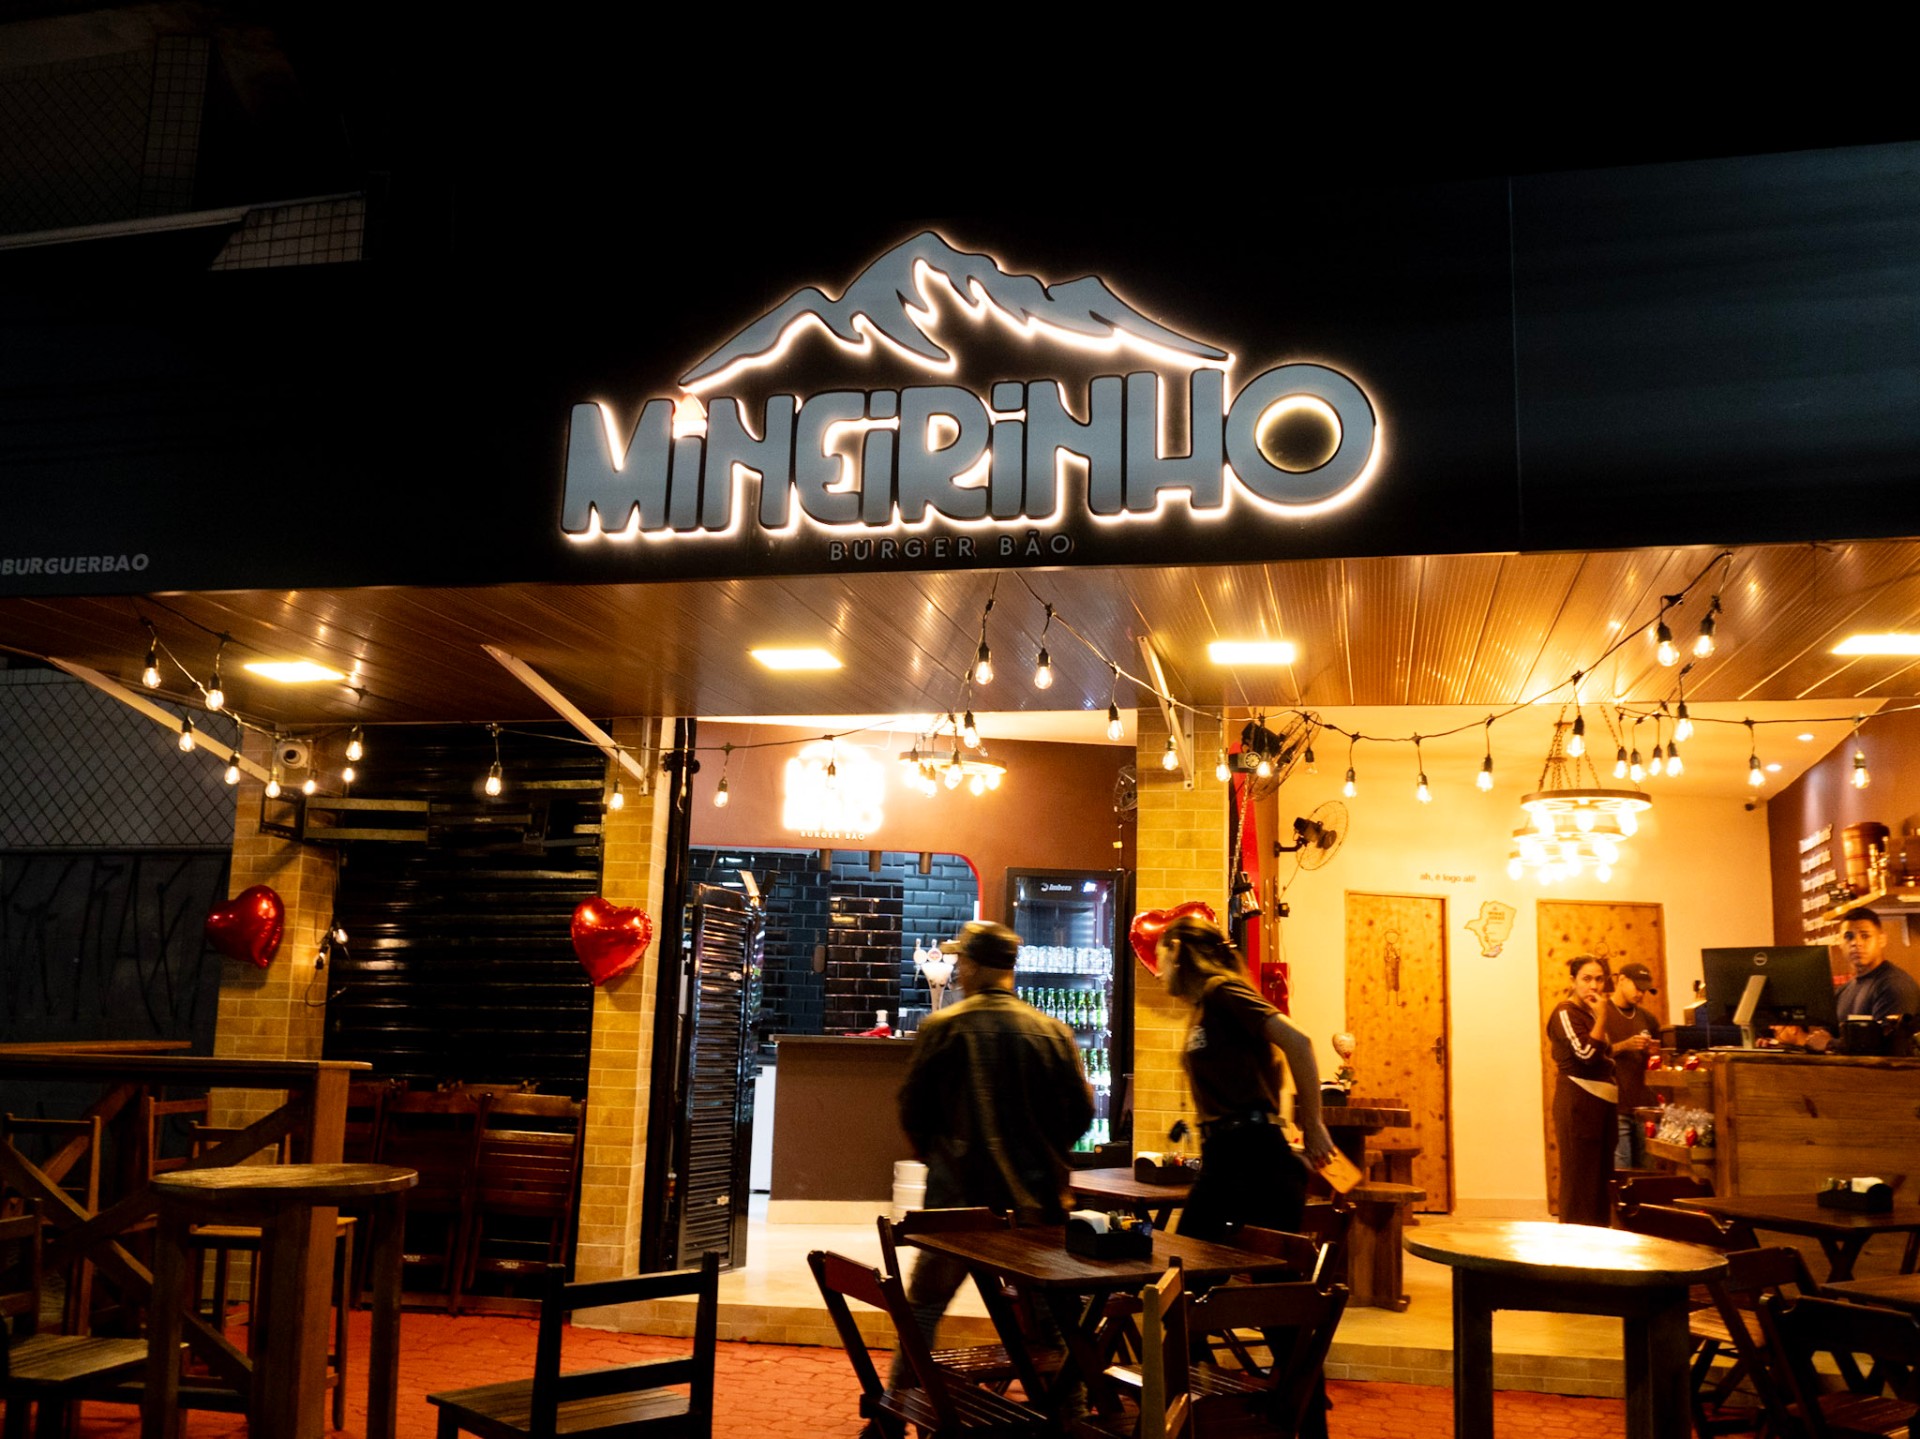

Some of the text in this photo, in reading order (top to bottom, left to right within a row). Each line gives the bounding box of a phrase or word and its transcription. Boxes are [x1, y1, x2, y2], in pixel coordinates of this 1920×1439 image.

[829, 530, 1071, 561] BURGER BÃO
[0, 553, 149, 575] BURGUERBAO
